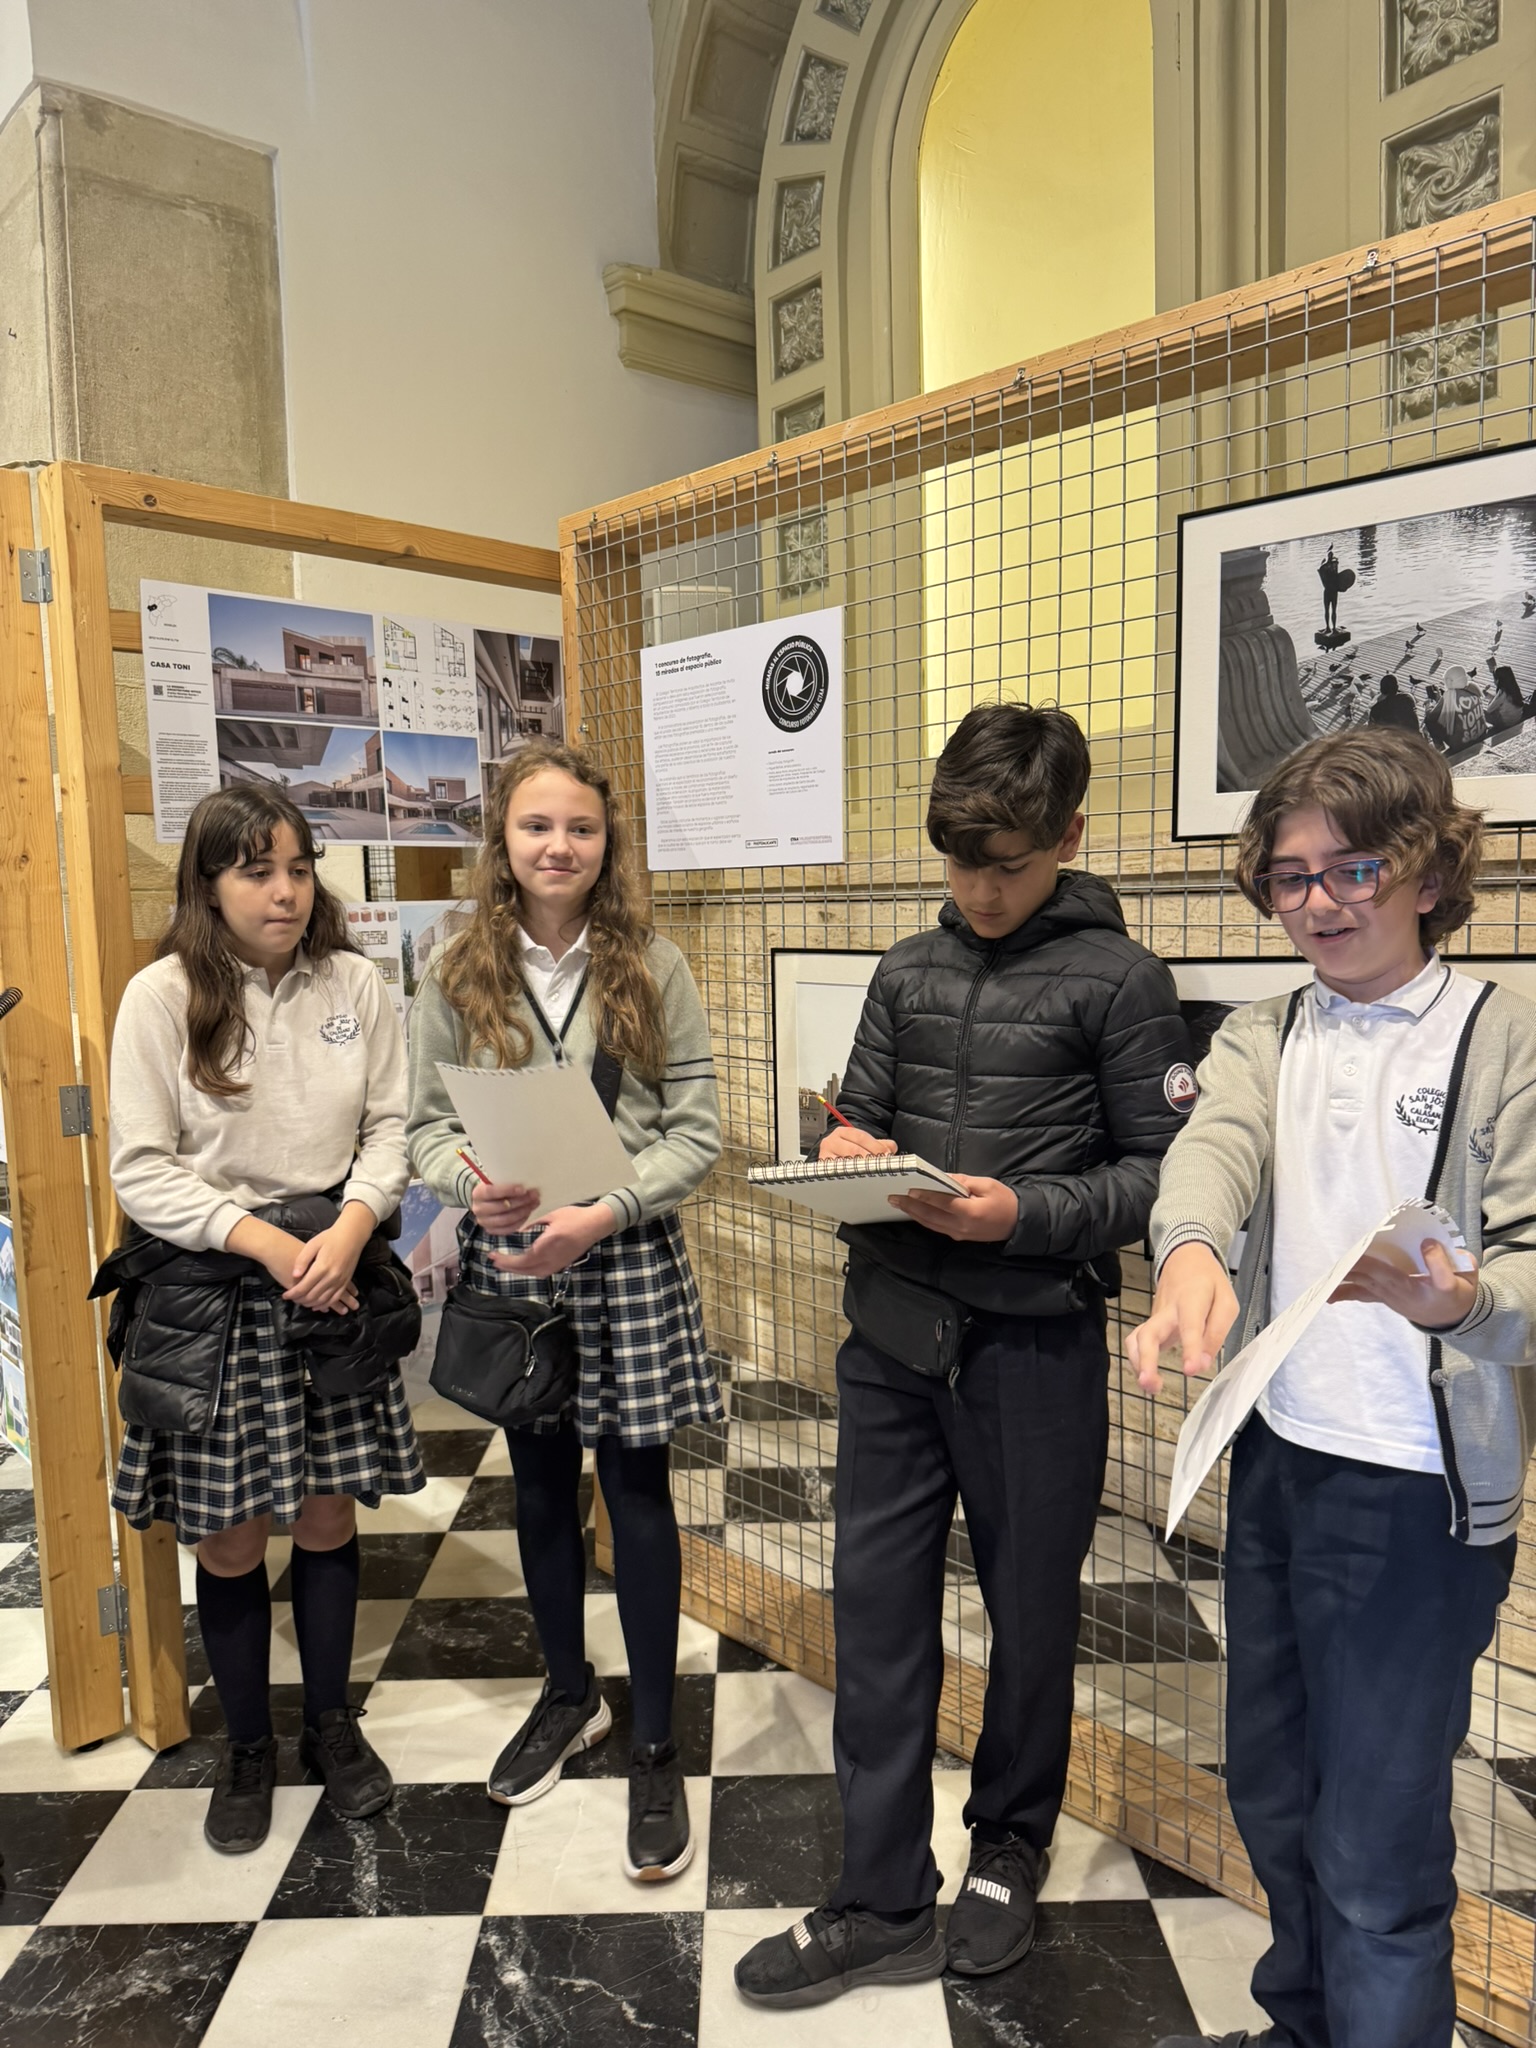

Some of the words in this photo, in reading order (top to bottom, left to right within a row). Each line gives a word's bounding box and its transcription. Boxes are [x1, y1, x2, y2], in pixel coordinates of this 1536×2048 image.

[150, 661, 171, 669] CASA
[658, 659, 679, 668] concurso
[661, 667, 679, 675] miradas
[685, 662, 704, 671] espacio
[704, 658, 722, 668] público
[778, 717, 800, 729] CONCURSO
[1408, 1094, 1428, 1103] SAN
[1430, 1096, 1446, 1108] JOS
[1424, 1103, 1433, 1111] DE
[1410, 1107, 1442, 1120] CALASAN
[1416, 1115, 1435, 1125] ELCHE
[966, 1876, 1012, 1905] PUMA
